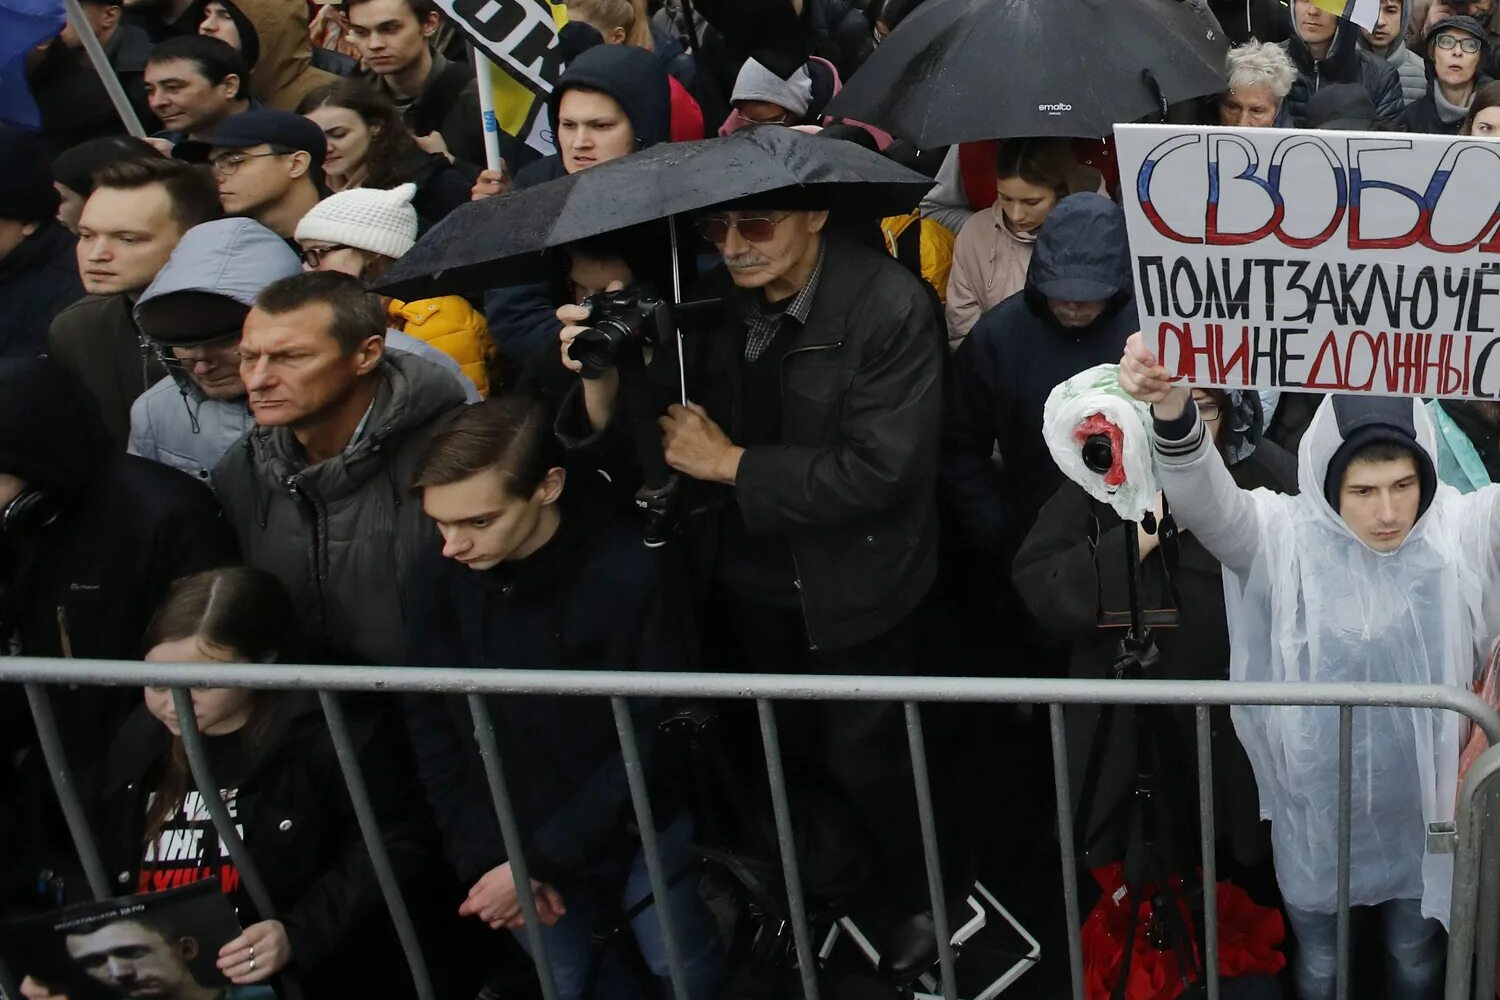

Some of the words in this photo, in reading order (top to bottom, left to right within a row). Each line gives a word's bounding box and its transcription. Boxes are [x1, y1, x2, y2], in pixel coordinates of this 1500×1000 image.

[1157, 320, 1250, 386] ОНИ
[1250, 327, 1305, 387] НЕ
[1301, 329, 1470, 394] ДОЛЖНЫ
